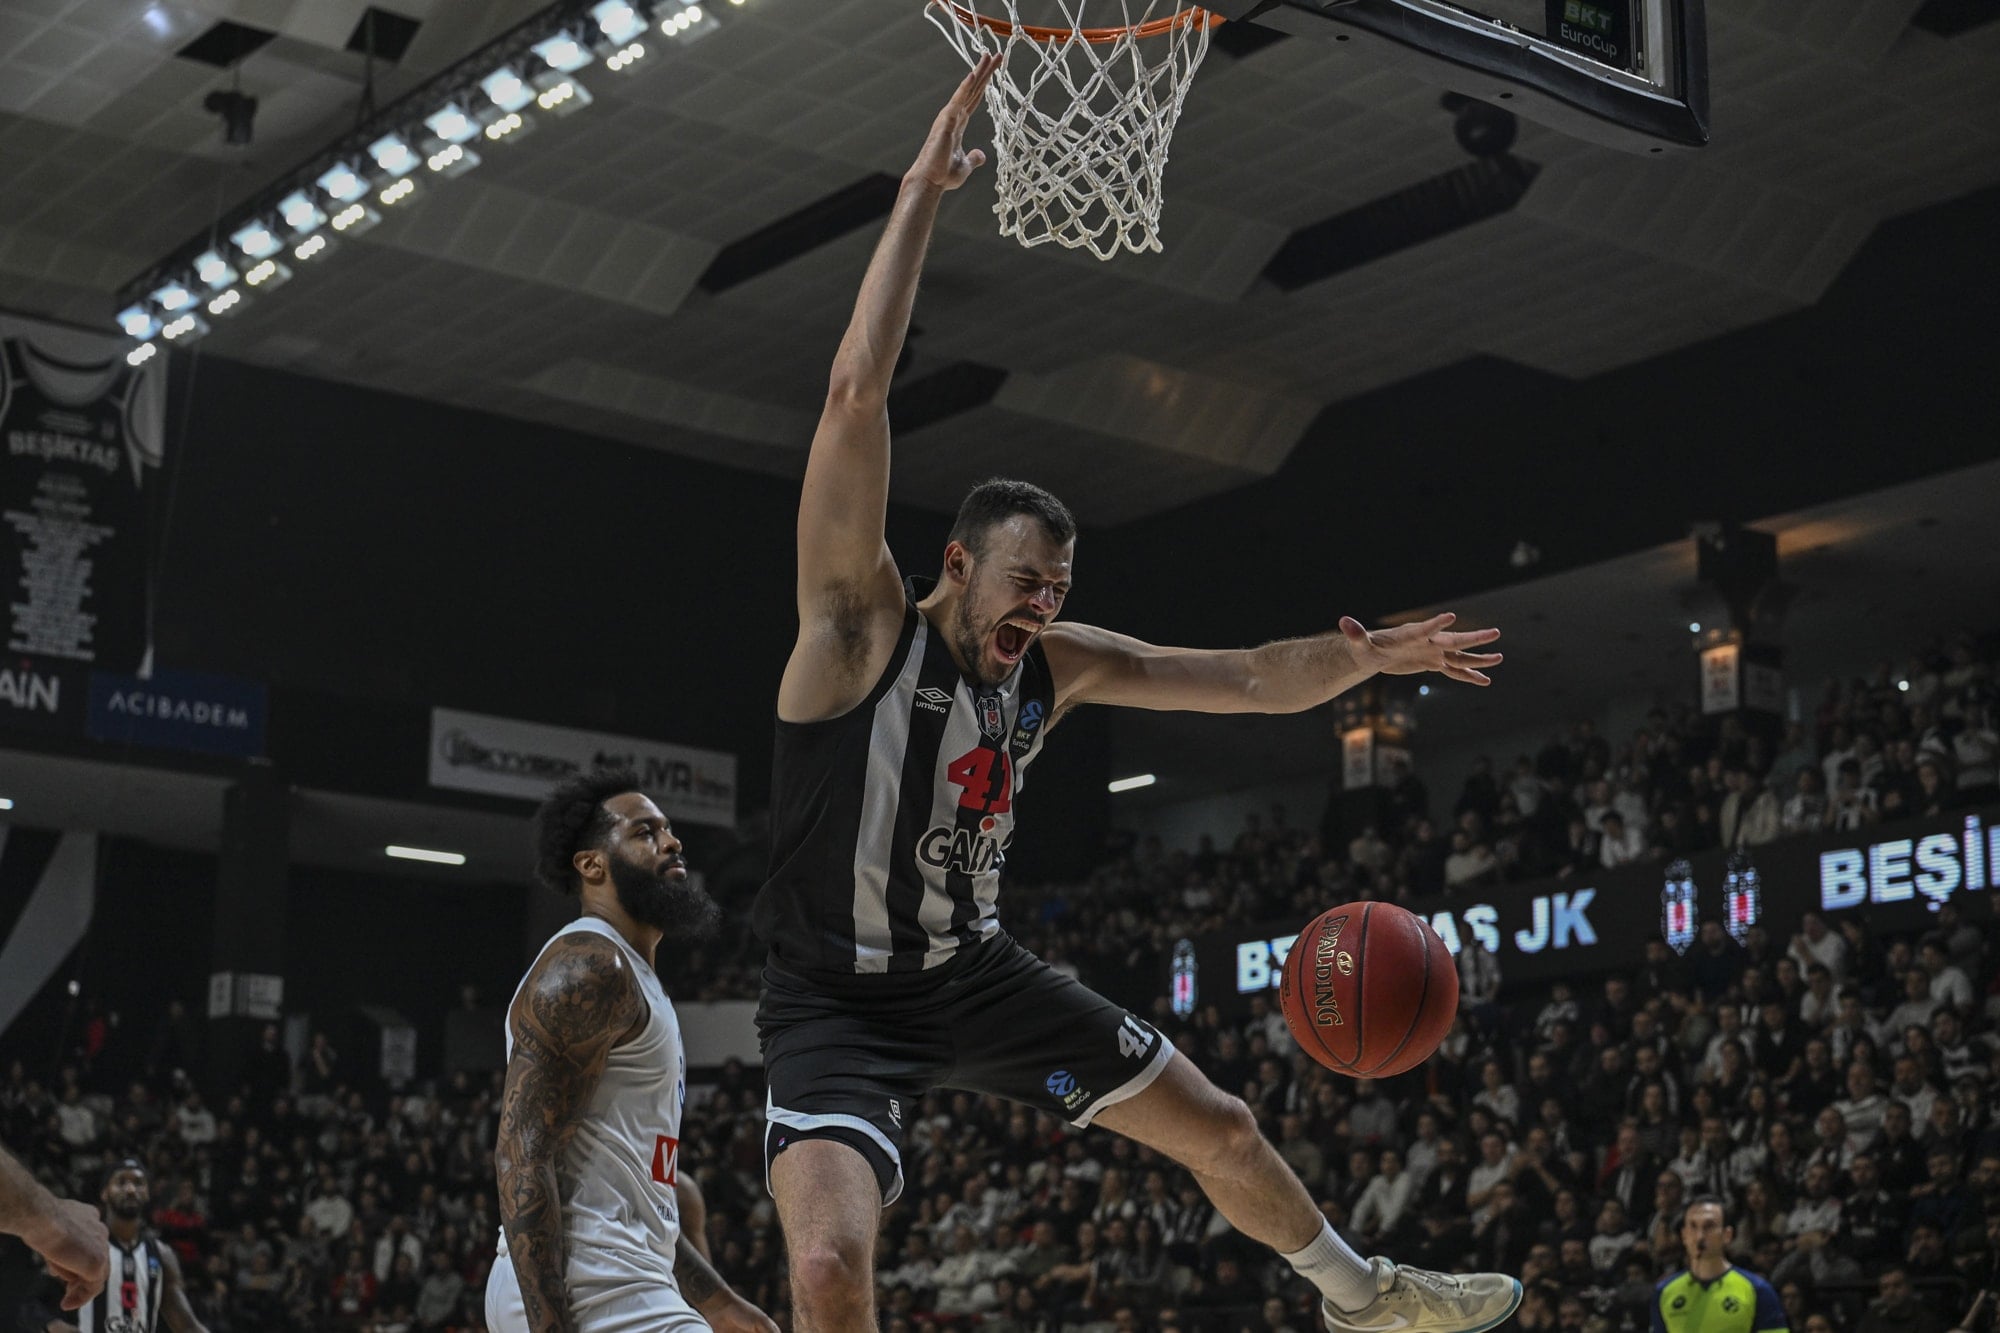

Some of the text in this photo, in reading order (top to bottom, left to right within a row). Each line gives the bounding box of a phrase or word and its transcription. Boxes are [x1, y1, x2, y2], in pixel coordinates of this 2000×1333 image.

[1561, 23, 1617, 57] EuroCup
[1566, 1, 1611, 29] BKT
[915, 700, 946, 713] umbro
[948, 746, 1012, 814] 41
[1820, 814, 2000, 912] BEŞİ
[1515, 888, 1597, 953] JK
[1315, 914, 1350, 1027] SPALDING
[1117, 1015, 1154, 1059] 41
